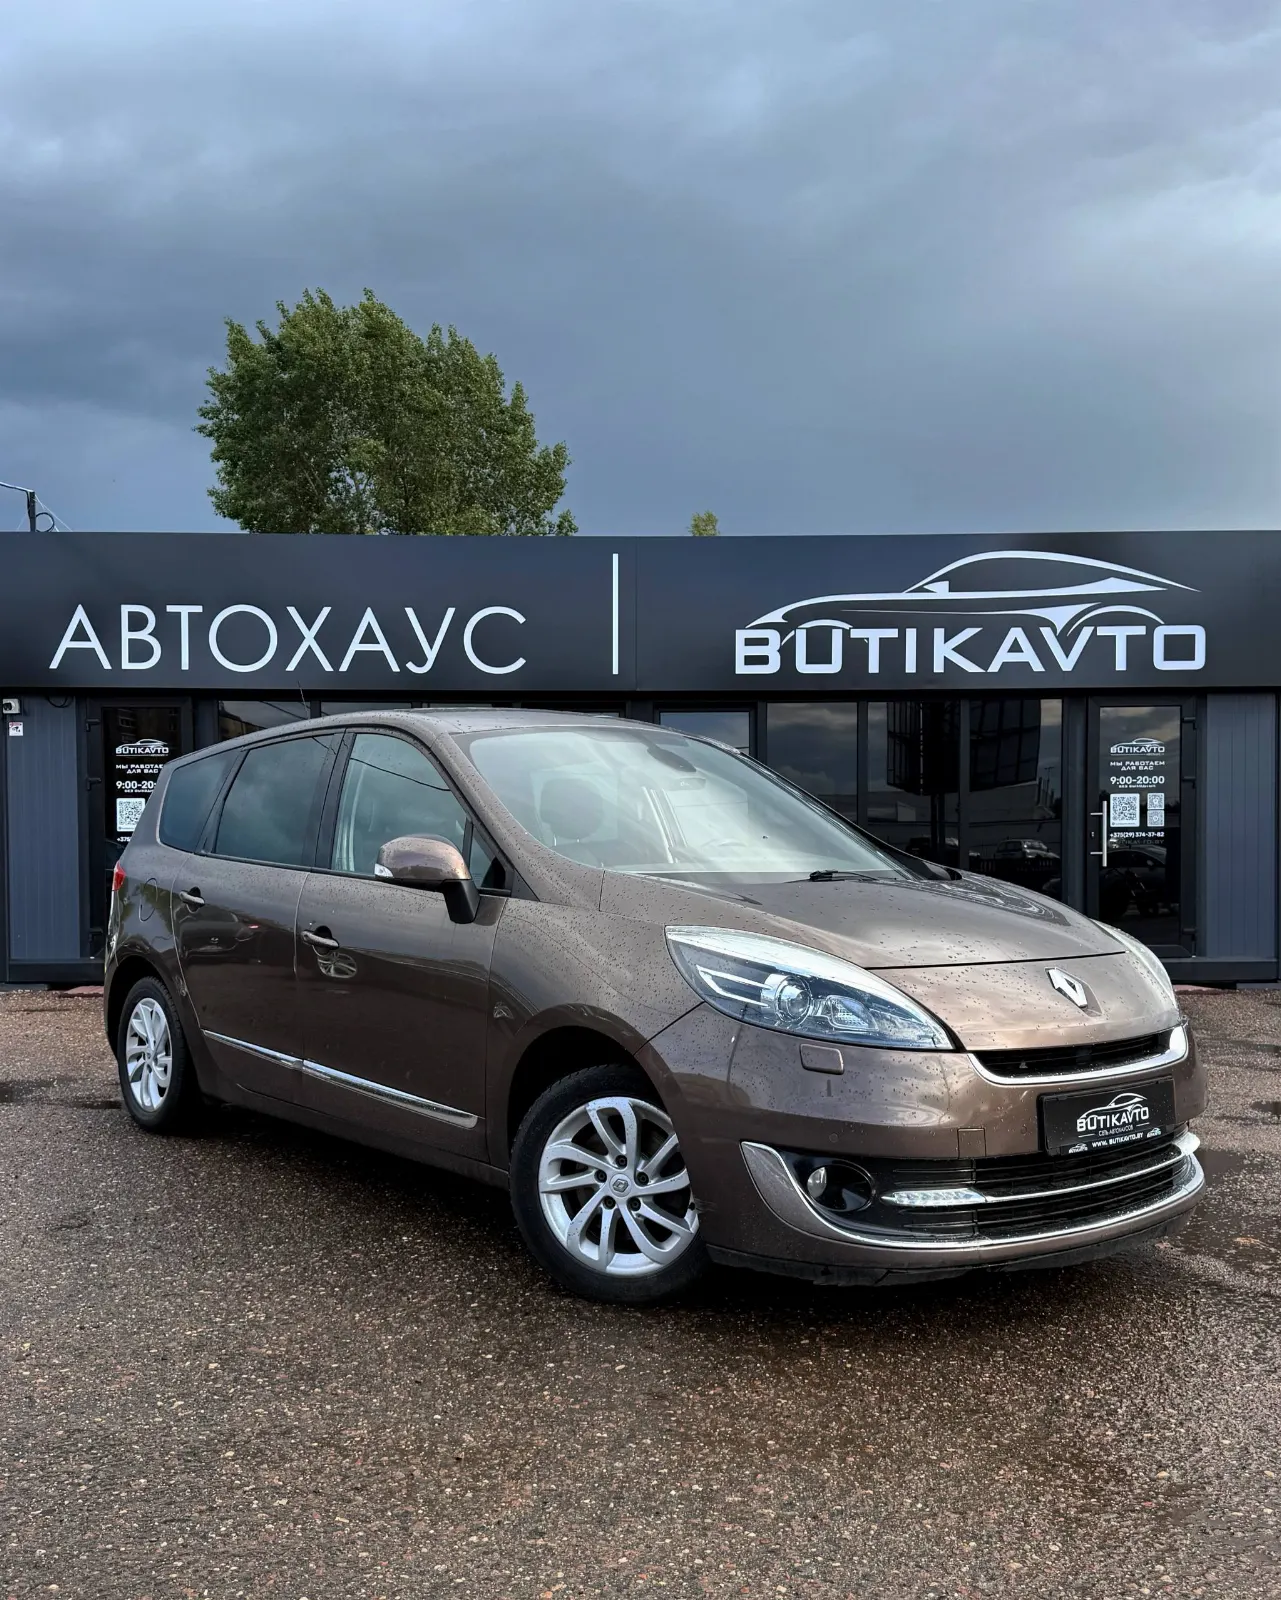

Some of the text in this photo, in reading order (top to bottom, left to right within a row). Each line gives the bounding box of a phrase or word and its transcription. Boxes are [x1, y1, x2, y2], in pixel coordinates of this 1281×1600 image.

[49, 603, 527, 675] АВТОХАУС
[735, 624, 1207, 675] BUTIKAVTO
[116, 781, 156, 789] 9:00-20:
[1110, 776, 1165, 785] 9:00-20:00
[1077, 1107, 1149, 1132] BUTIKAVTO
